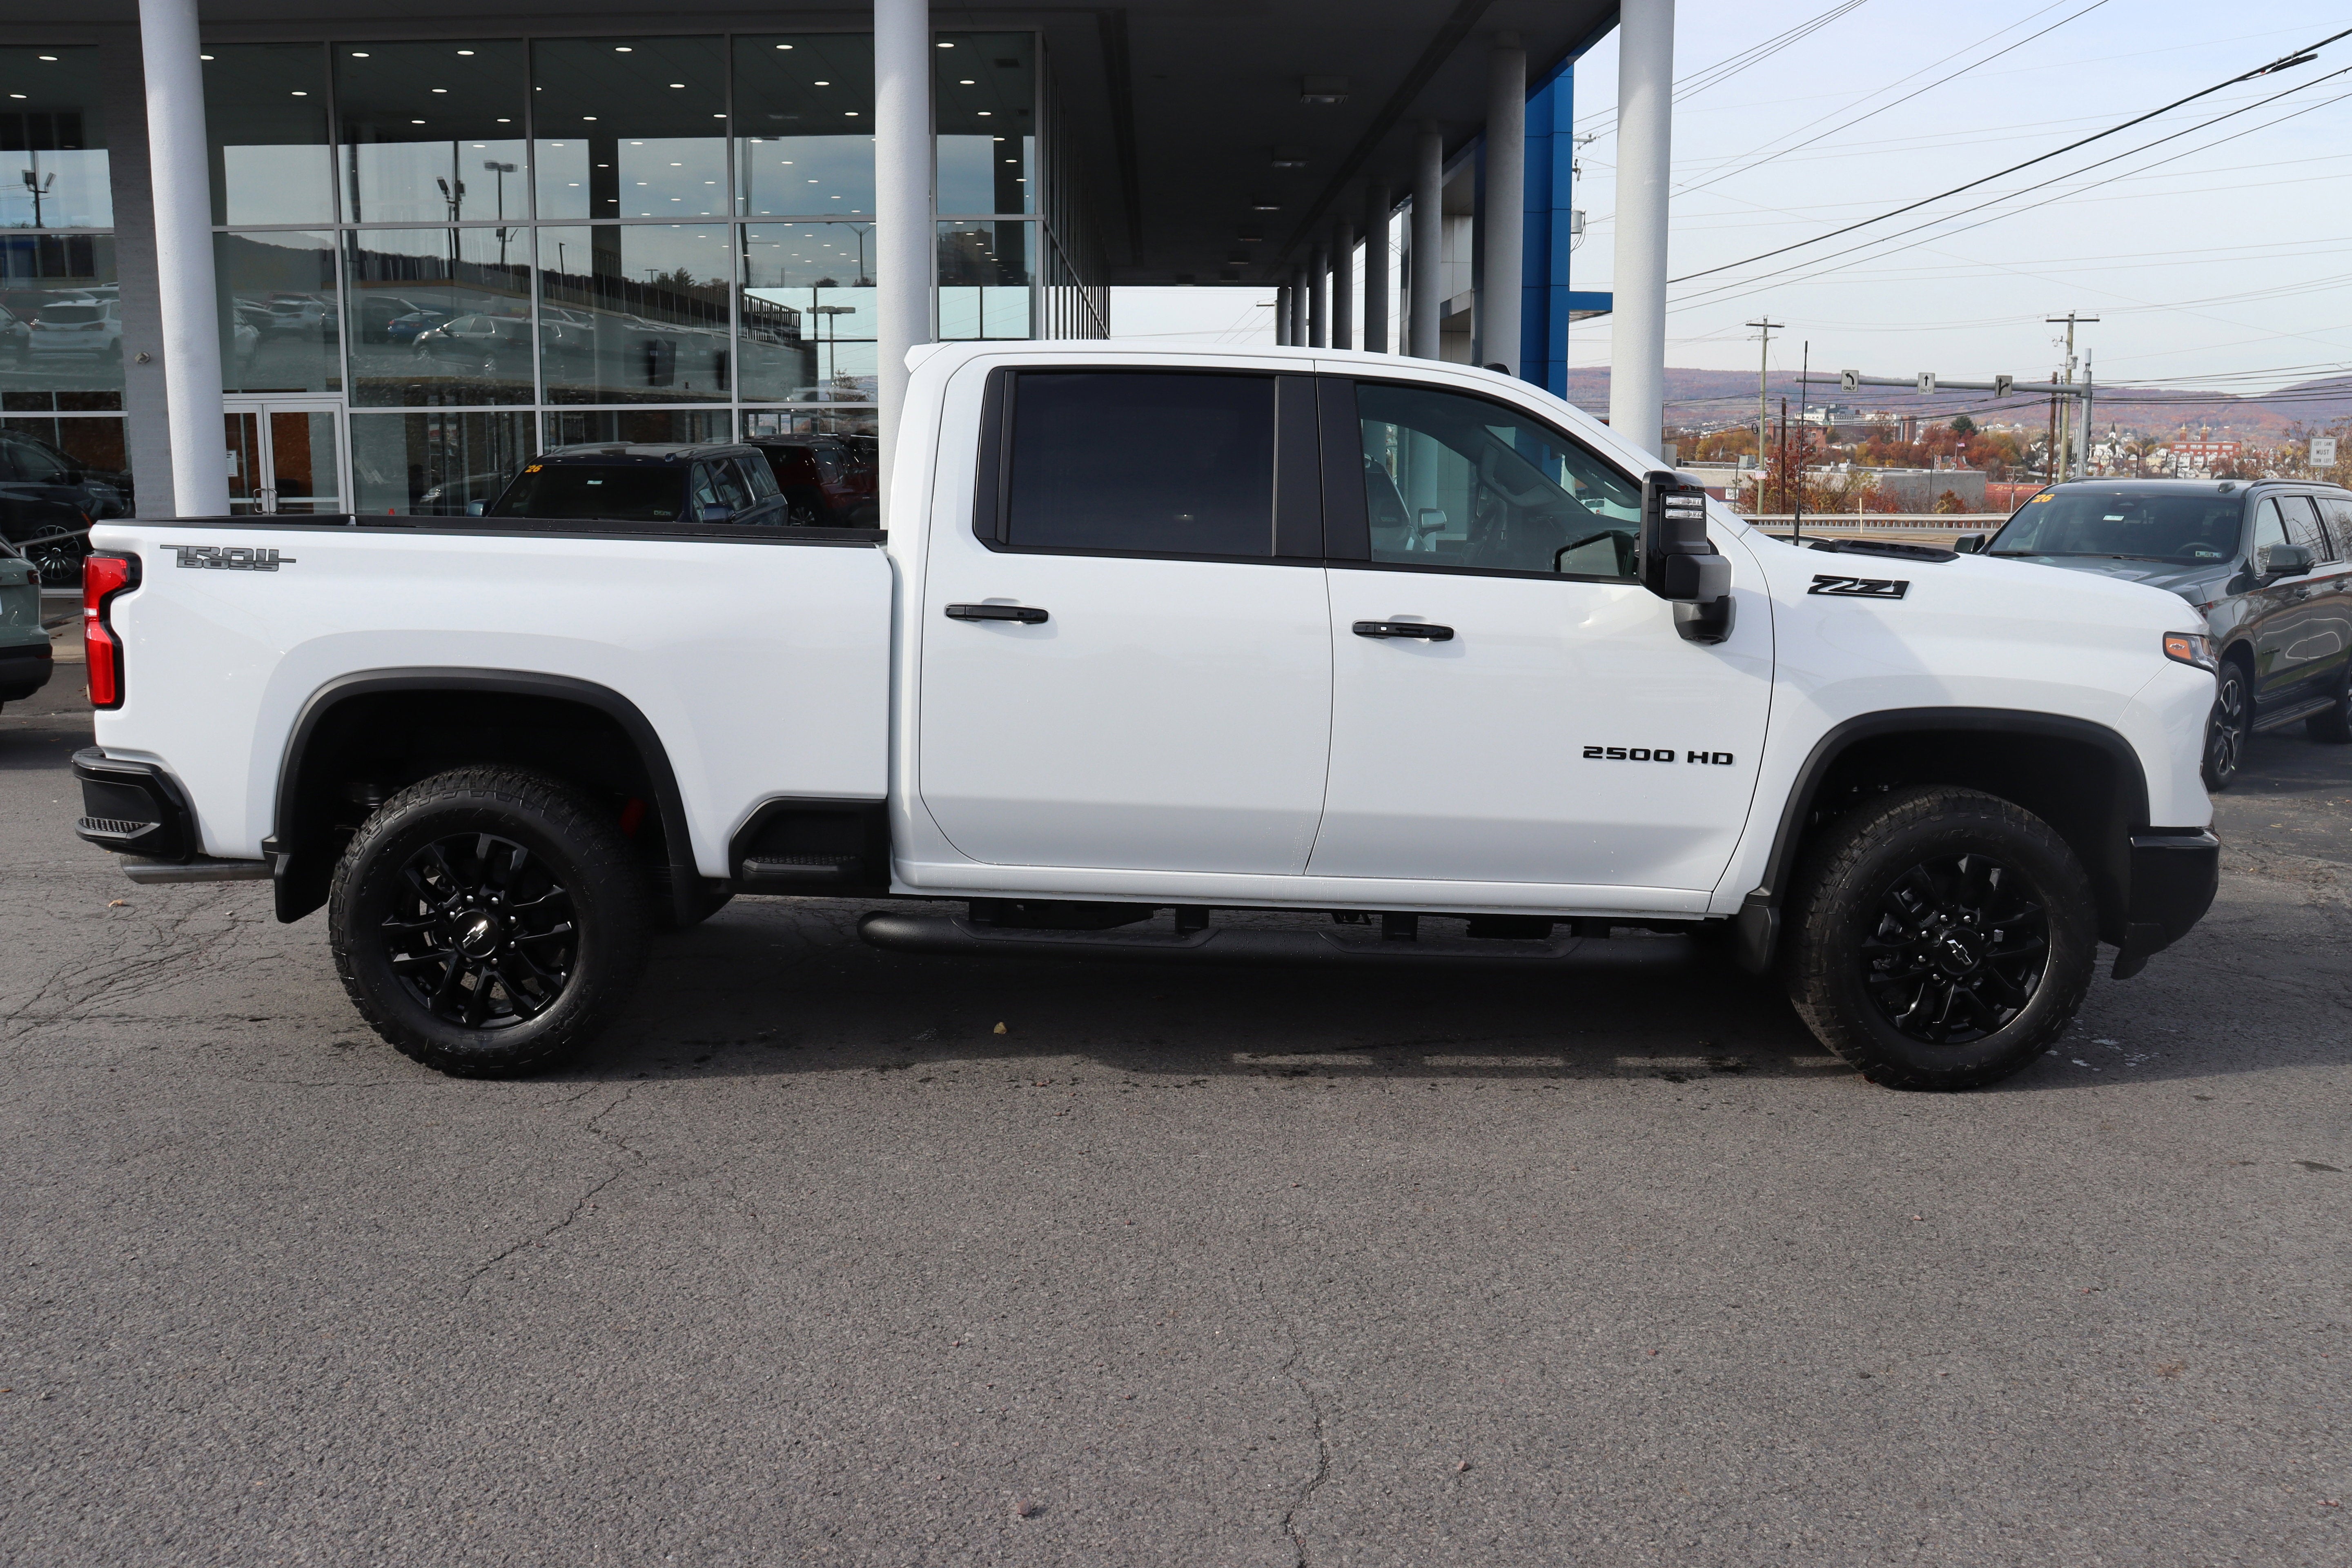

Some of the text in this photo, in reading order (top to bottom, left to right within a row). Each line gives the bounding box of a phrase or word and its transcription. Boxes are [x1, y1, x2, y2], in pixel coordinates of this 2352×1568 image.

[160, 545, 296, 563] TRAIL
[177, 557, 279, 572] BOSS
[1807, 574, 1910, 599] Z71
[1583, 746, 1733, 765] 2500 HD
